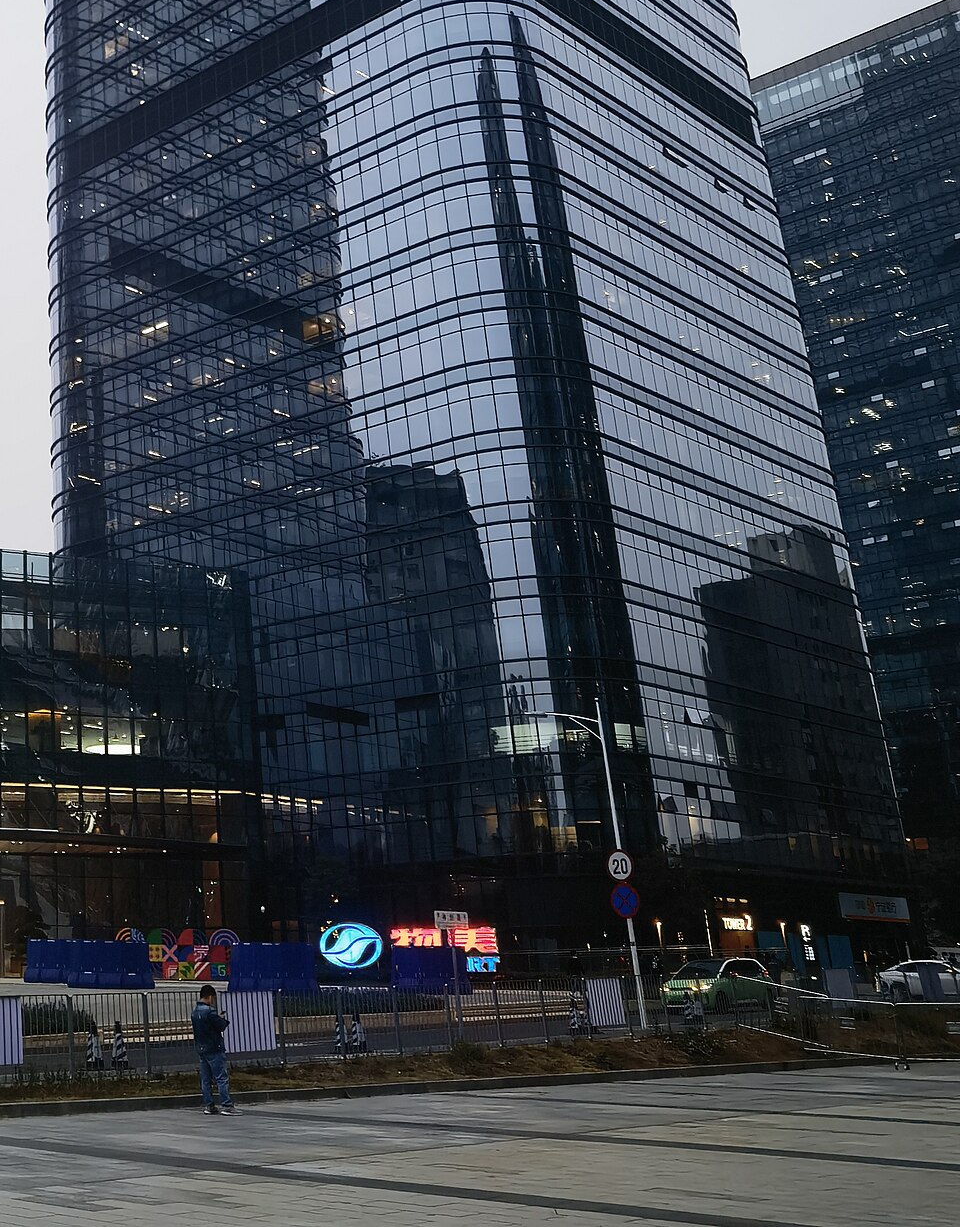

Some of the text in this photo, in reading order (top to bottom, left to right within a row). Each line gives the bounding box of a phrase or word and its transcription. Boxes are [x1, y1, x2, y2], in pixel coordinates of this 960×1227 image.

[612, 858, 628, 875] 20
[722, 914, 753, 931] TOWER 2
